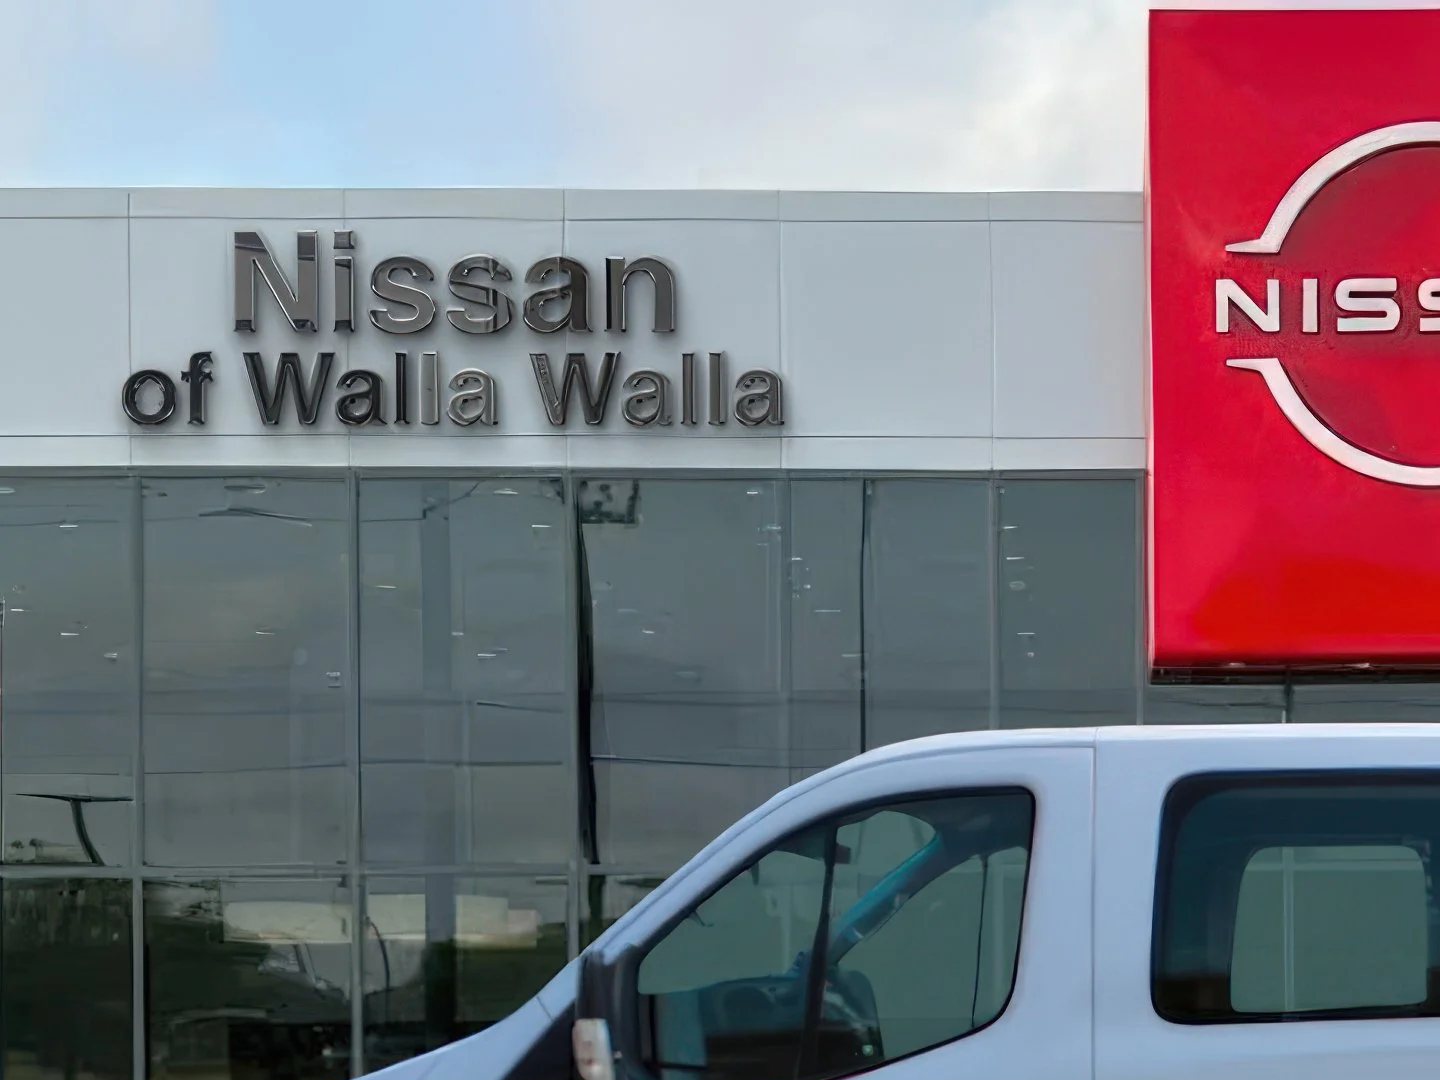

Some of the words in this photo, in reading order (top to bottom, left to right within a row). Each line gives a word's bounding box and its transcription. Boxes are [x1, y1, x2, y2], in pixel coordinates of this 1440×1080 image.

[233, 230, 677, 335] Nissan
[122, 351, 214, 426] of
[243, 351, 499, 427] Walla
[529, 351, 785, 427] Walla
